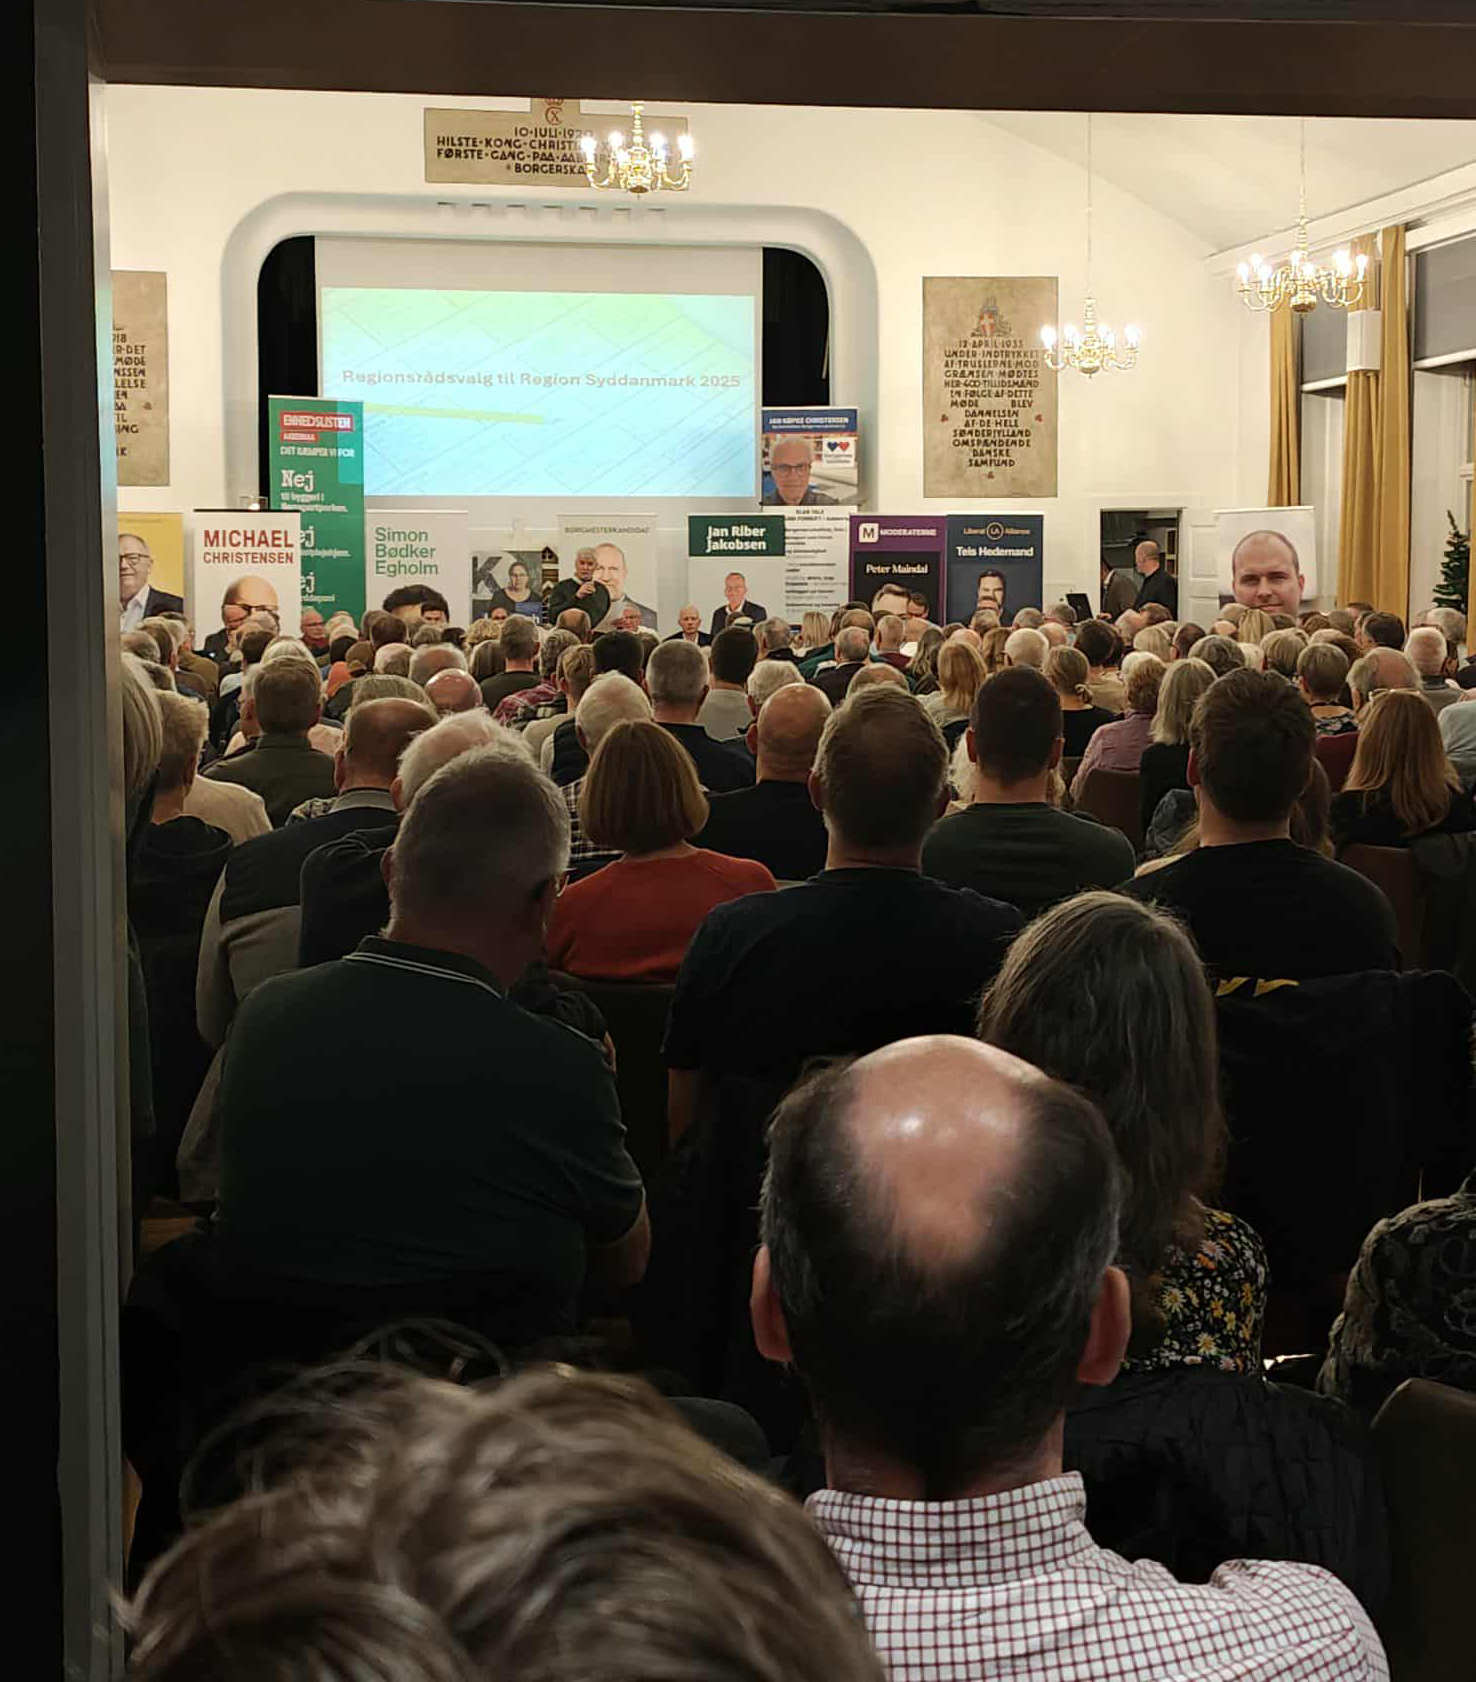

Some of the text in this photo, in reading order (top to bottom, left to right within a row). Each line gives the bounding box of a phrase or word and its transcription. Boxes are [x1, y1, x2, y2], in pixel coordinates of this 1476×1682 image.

[342, 370, 741, 388] Regionsrådsvalg til Region Syddanmark 2025
[281, 470, 314, 492] Nej
[203, 529, 294, 548] MICHAEL
[375, 527, 429, 543] Simon
[706, 525, 767, 540] Jan Riber
[863, 528, 875, 538] M
[375, 543, 436, 559] Bødker
[706, 539, 767, 553] Jakobsen
[979, 546, 1034, 556] Hedemand
[203, 551, 293, 564] CHRISTENSEN
[375, 560, 438, 578] Egholm
[866, 564, 890, 574] Peter
